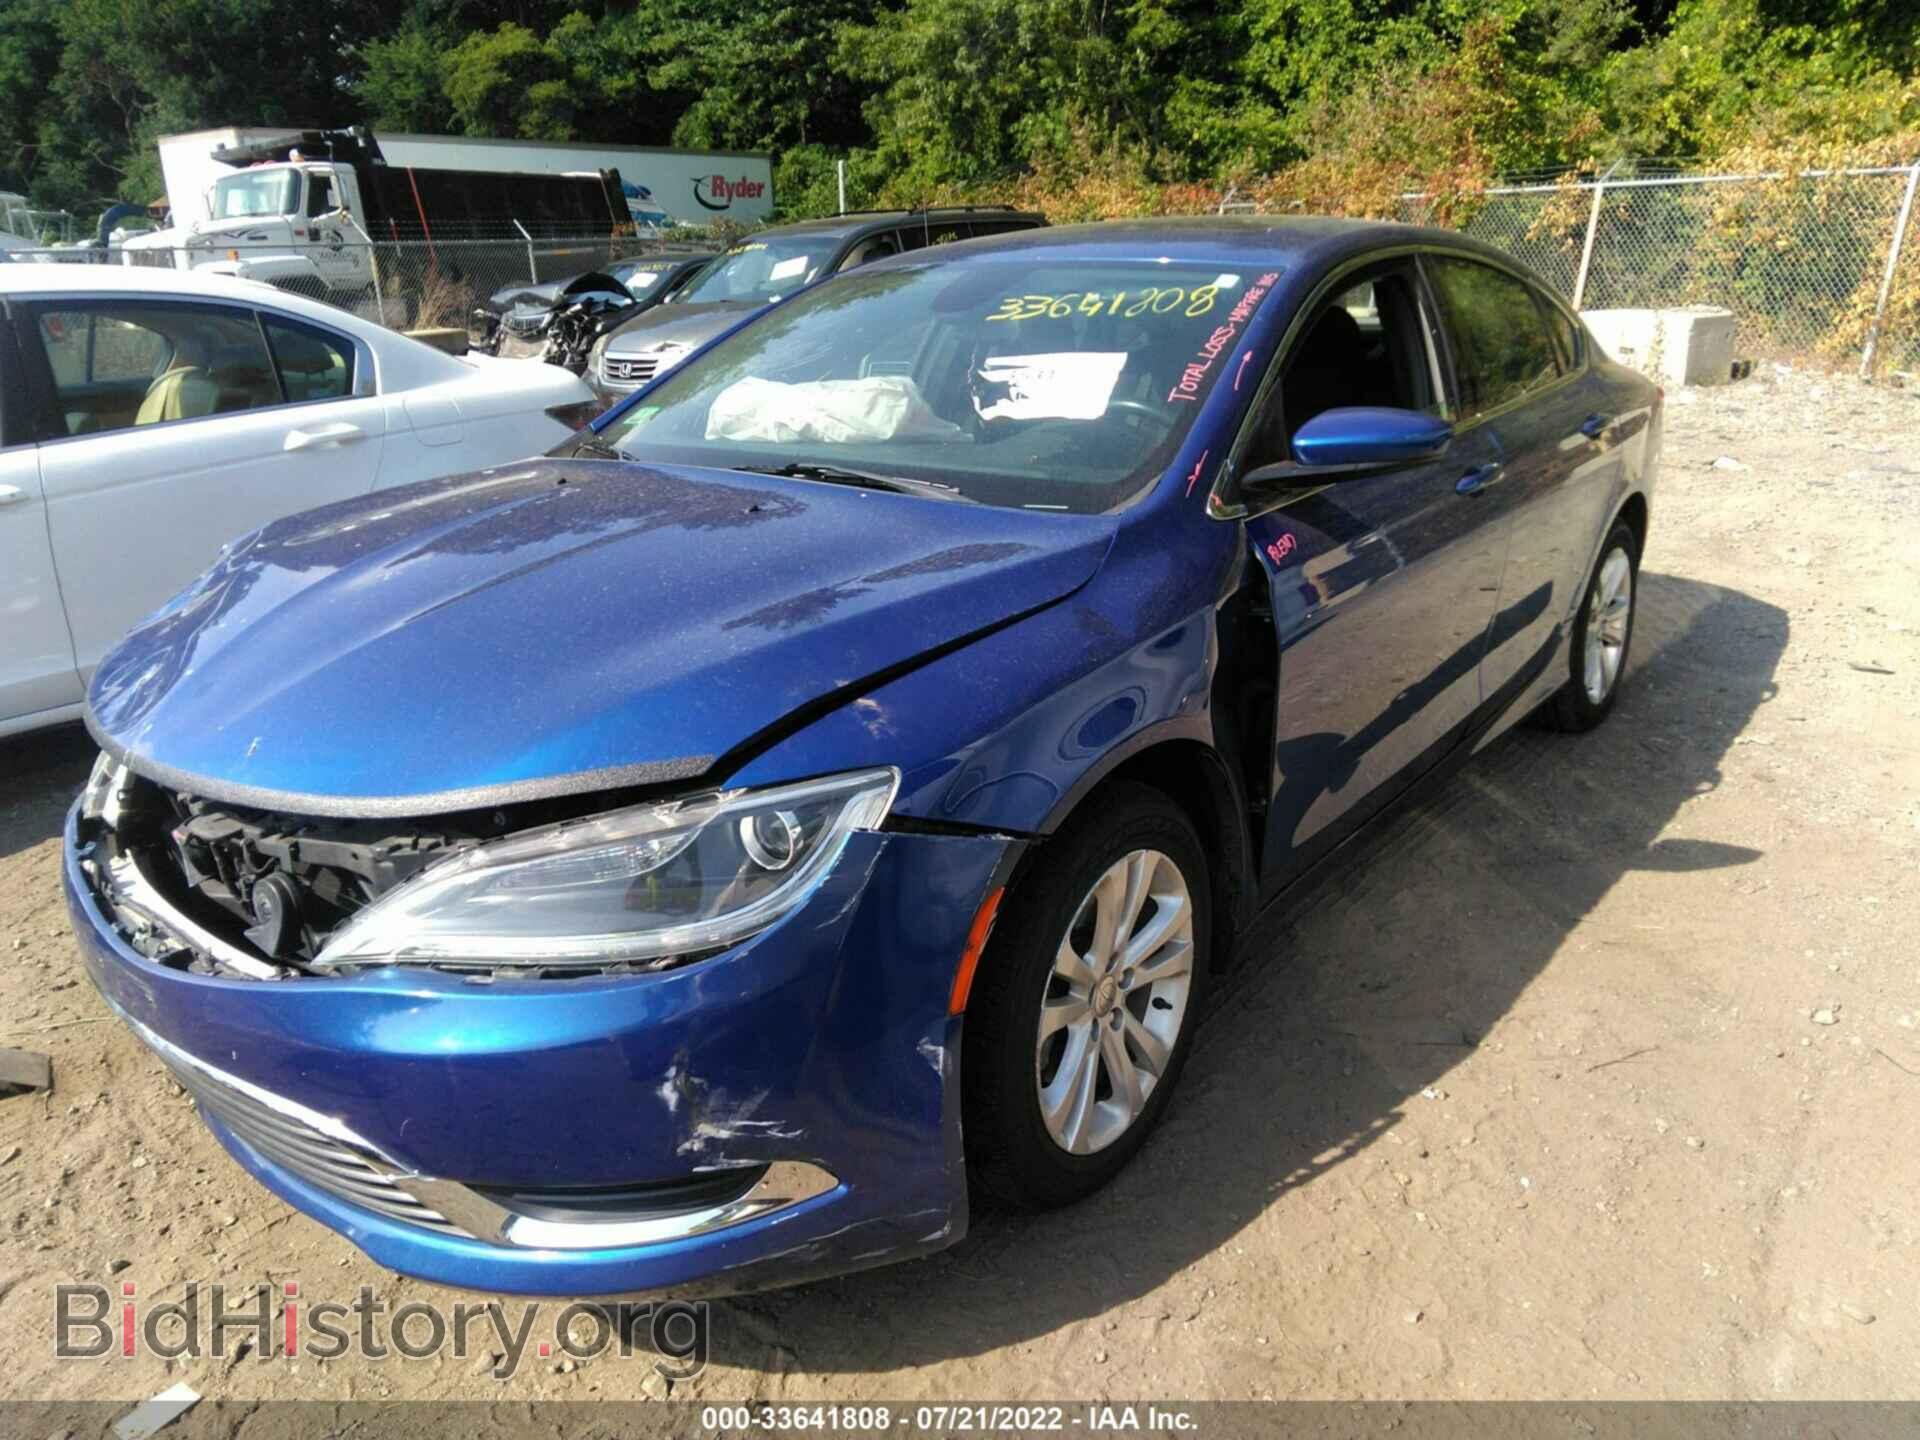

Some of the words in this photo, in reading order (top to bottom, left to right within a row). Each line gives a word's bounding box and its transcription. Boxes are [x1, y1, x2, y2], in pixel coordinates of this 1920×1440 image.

[712, 175, 765, 203] Ryder
[985, 284, 1219, 321] 33641808
[1168, 360, 1212, 402] TOTAL
